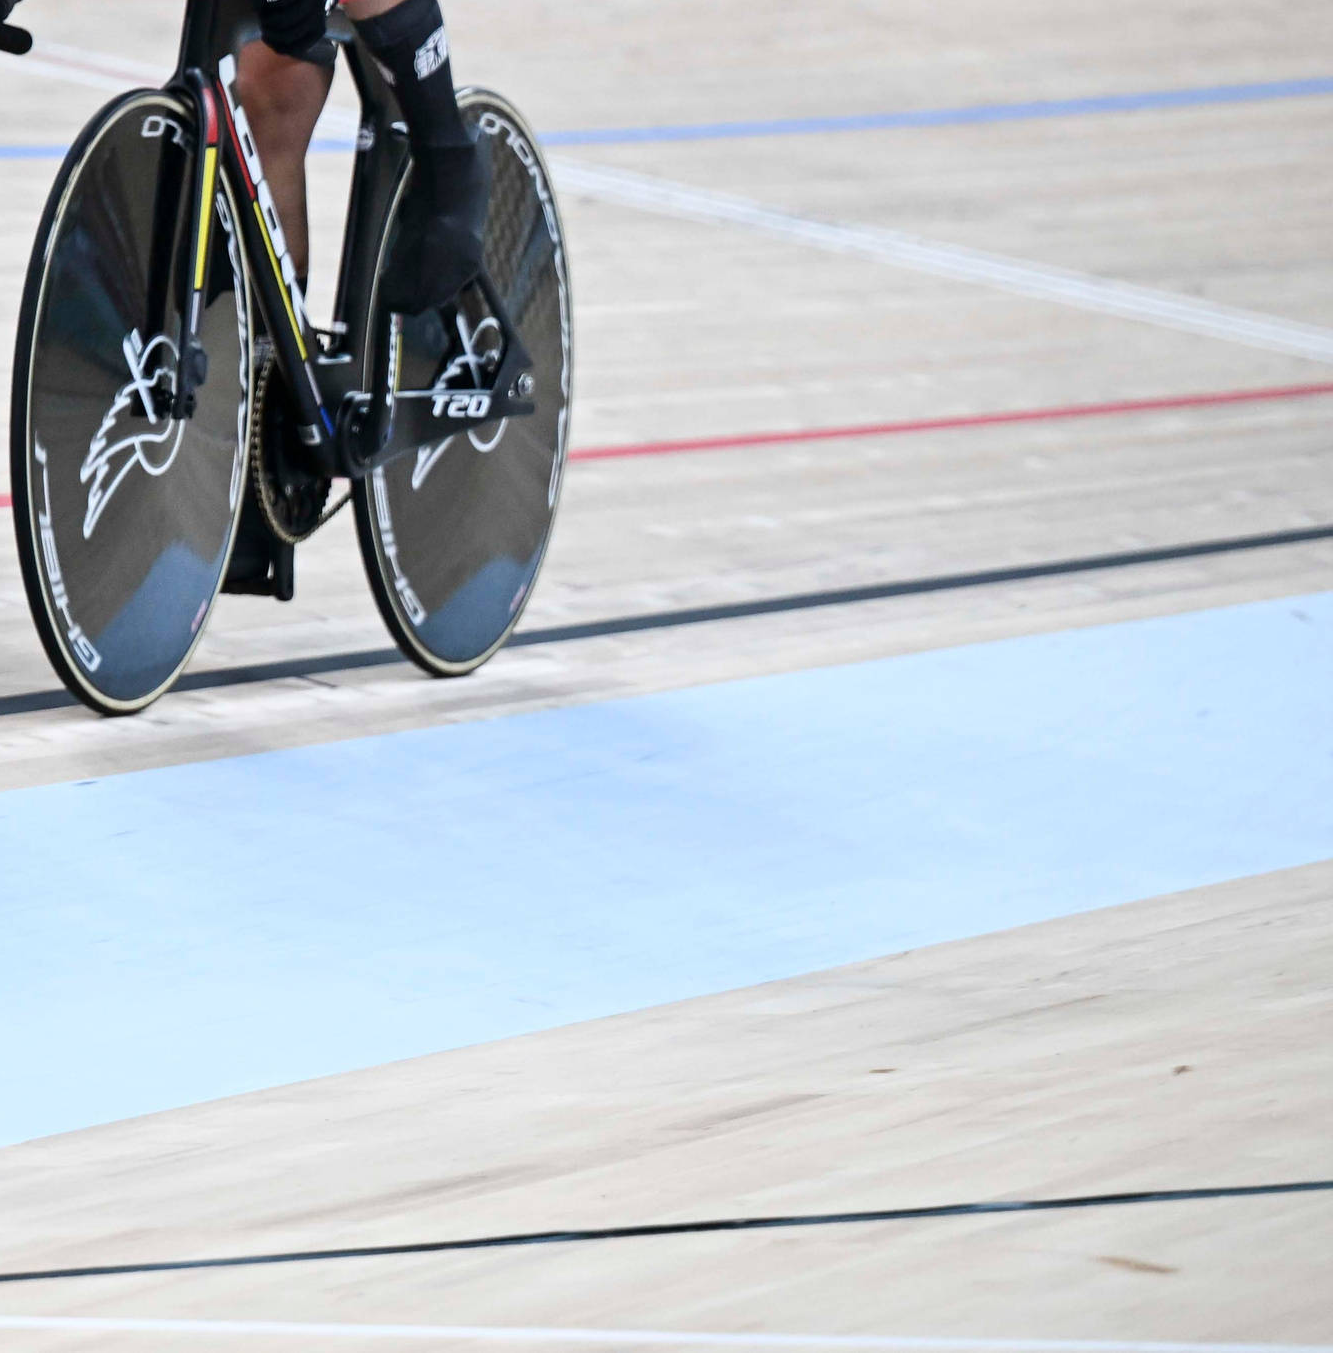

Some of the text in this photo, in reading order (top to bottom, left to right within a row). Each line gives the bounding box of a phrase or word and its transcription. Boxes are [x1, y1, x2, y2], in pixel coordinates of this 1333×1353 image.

[218, 53, 305, 336] LOOK
[432, 395, 491, 418] T20
[35, 431, 102, 672] GHIBLI
